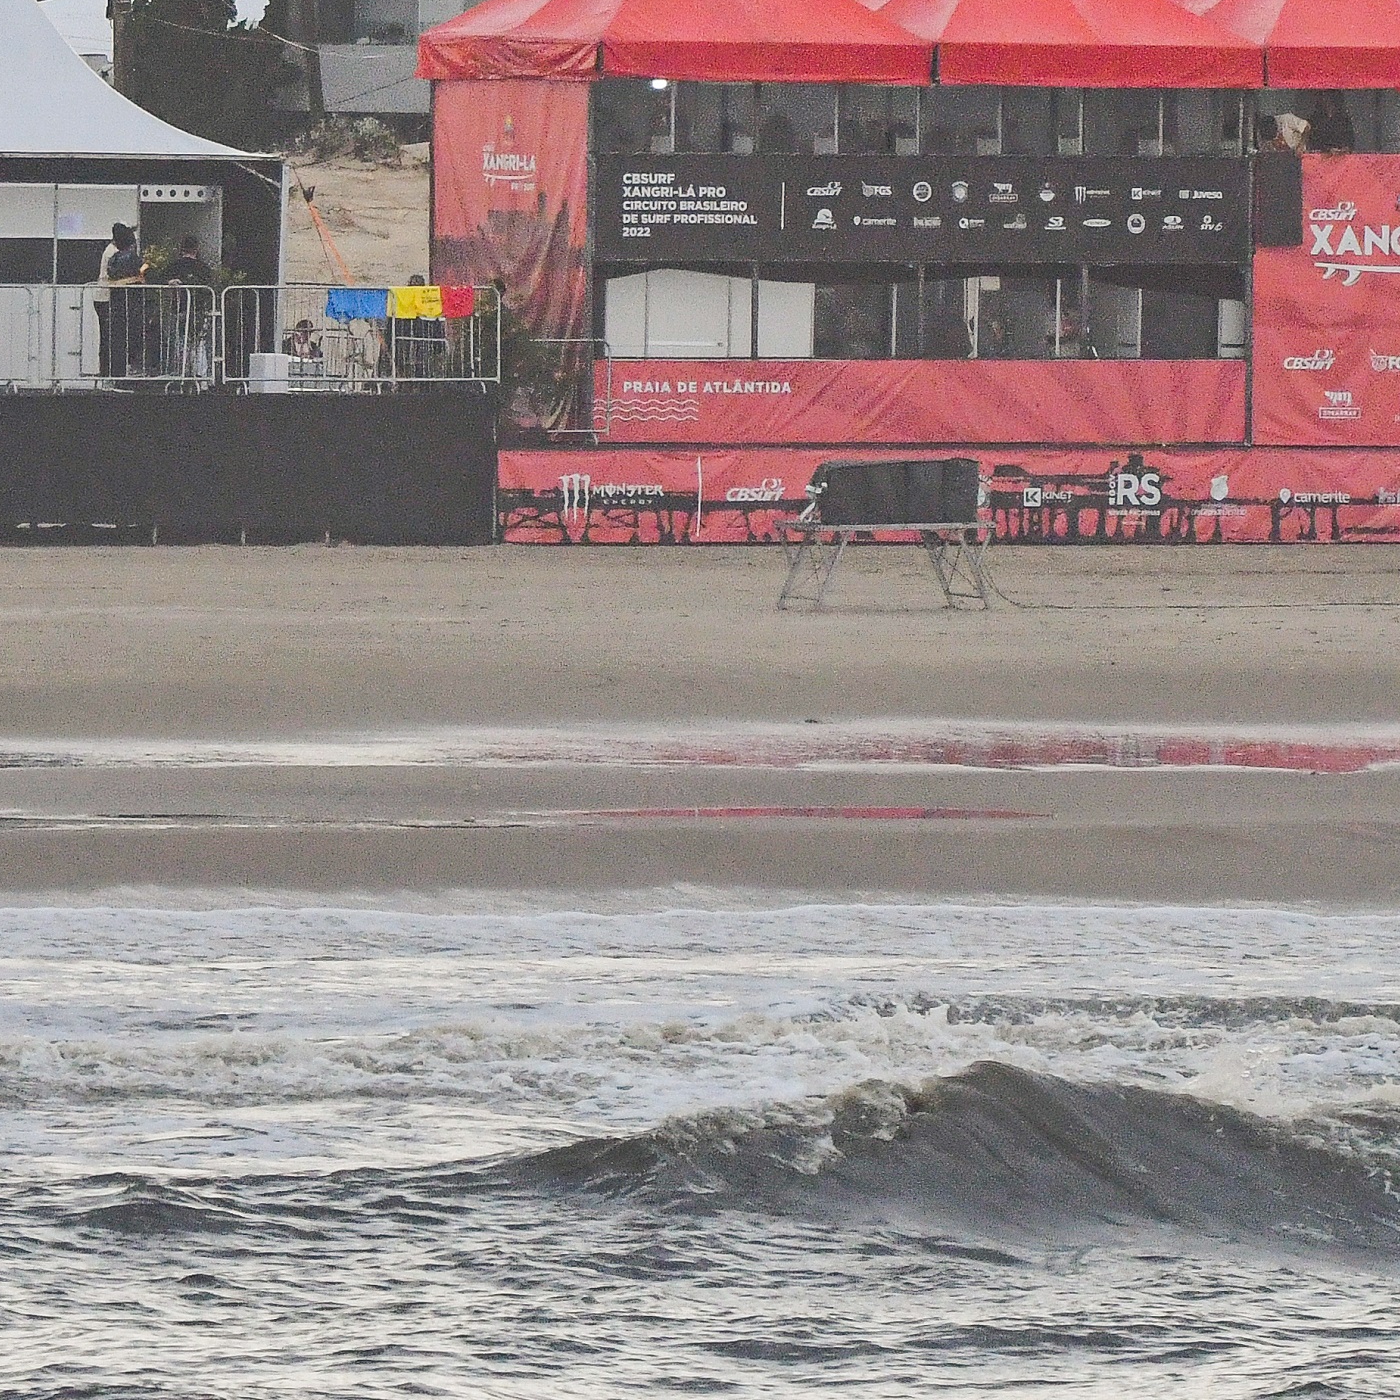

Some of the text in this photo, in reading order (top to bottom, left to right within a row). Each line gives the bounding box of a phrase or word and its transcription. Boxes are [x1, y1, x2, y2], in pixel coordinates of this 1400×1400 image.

[622, 173, 676, 185] CBSURF
[622, 183, 727, 198] XANGRI-LÁ PRO
[622, 200, 748, 212] CIRCUITO BRASILEIRO
[622, 213, 758, 225] DE SURF PROFISSIONAL
[622, 226, 652, 237] 2022
[622, 378, 792, 394] PRAIA DE ATLÂNTIDA
[592, 482, 665, 499] MONSTER
[1041, 490, 1074, 502] KINET
[1116, 473, 1162, 506] RS
[1293, 490, 1351, 505] camerite
